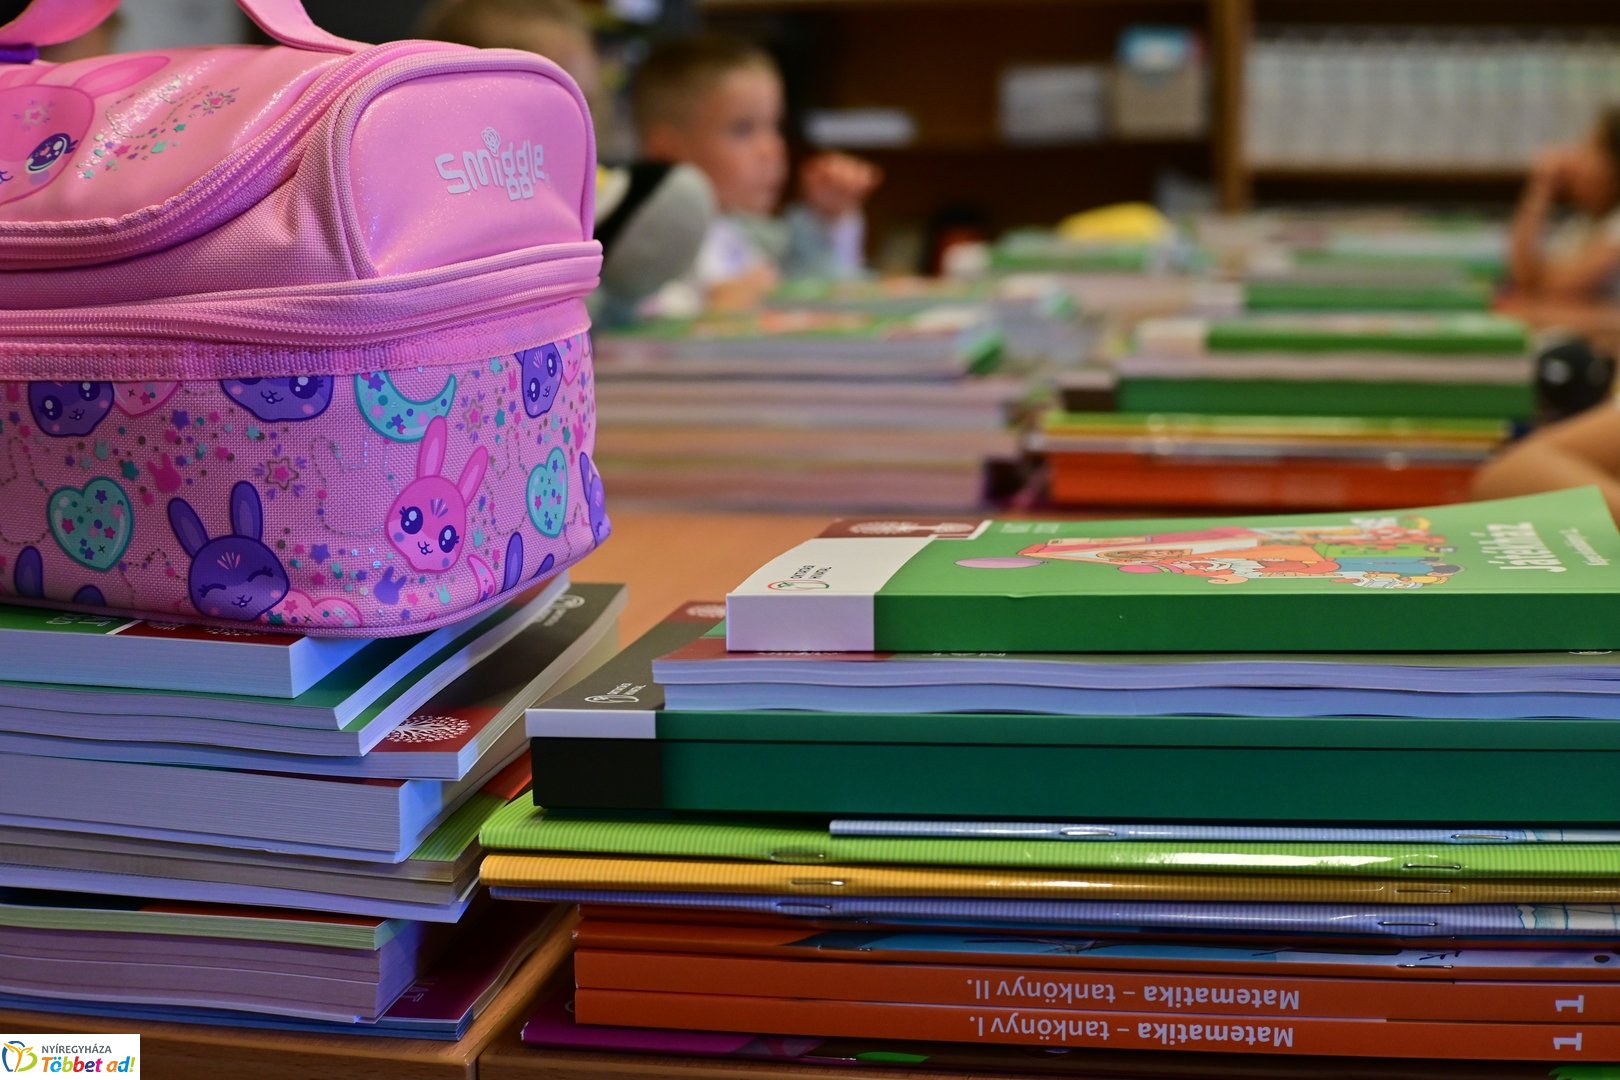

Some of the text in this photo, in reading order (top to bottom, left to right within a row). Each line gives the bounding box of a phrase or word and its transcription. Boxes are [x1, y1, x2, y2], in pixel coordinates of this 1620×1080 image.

[967, 979, 990, 1000] II.
[996, 976, 1116, 1004] tankönyv
[1143, 985, 1300, 1010] Matematika
[1555, 995, 1585, 1013] 1
[969, 1016, 984, 1037] I.
[990, 1012, 1110, 1041] tankönyv
[1137, 1022, 1294, 1048] Matematika
[1553, 1032, 1583, 1051] 1
